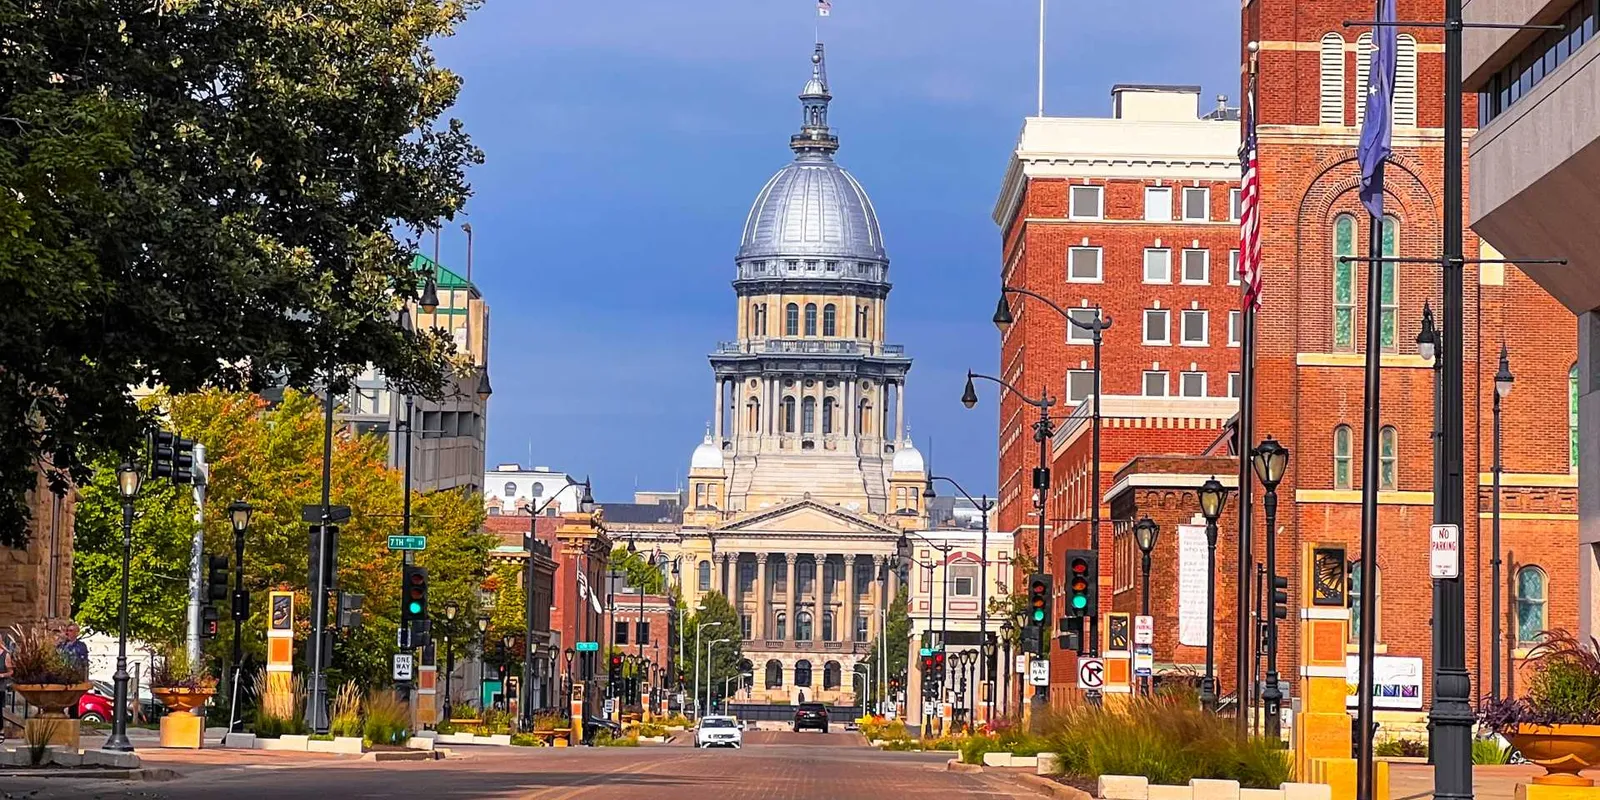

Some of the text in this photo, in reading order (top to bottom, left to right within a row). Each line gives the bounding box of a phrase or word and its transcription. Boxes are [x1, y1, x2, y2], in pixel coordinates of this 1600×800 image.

[1439, 529, 1449, 539] NO
[390, 538, 404, 547] 7TH
[1432, 541, 1456, 551] PARKING
[1032, 661, 1046, 669] ONE
